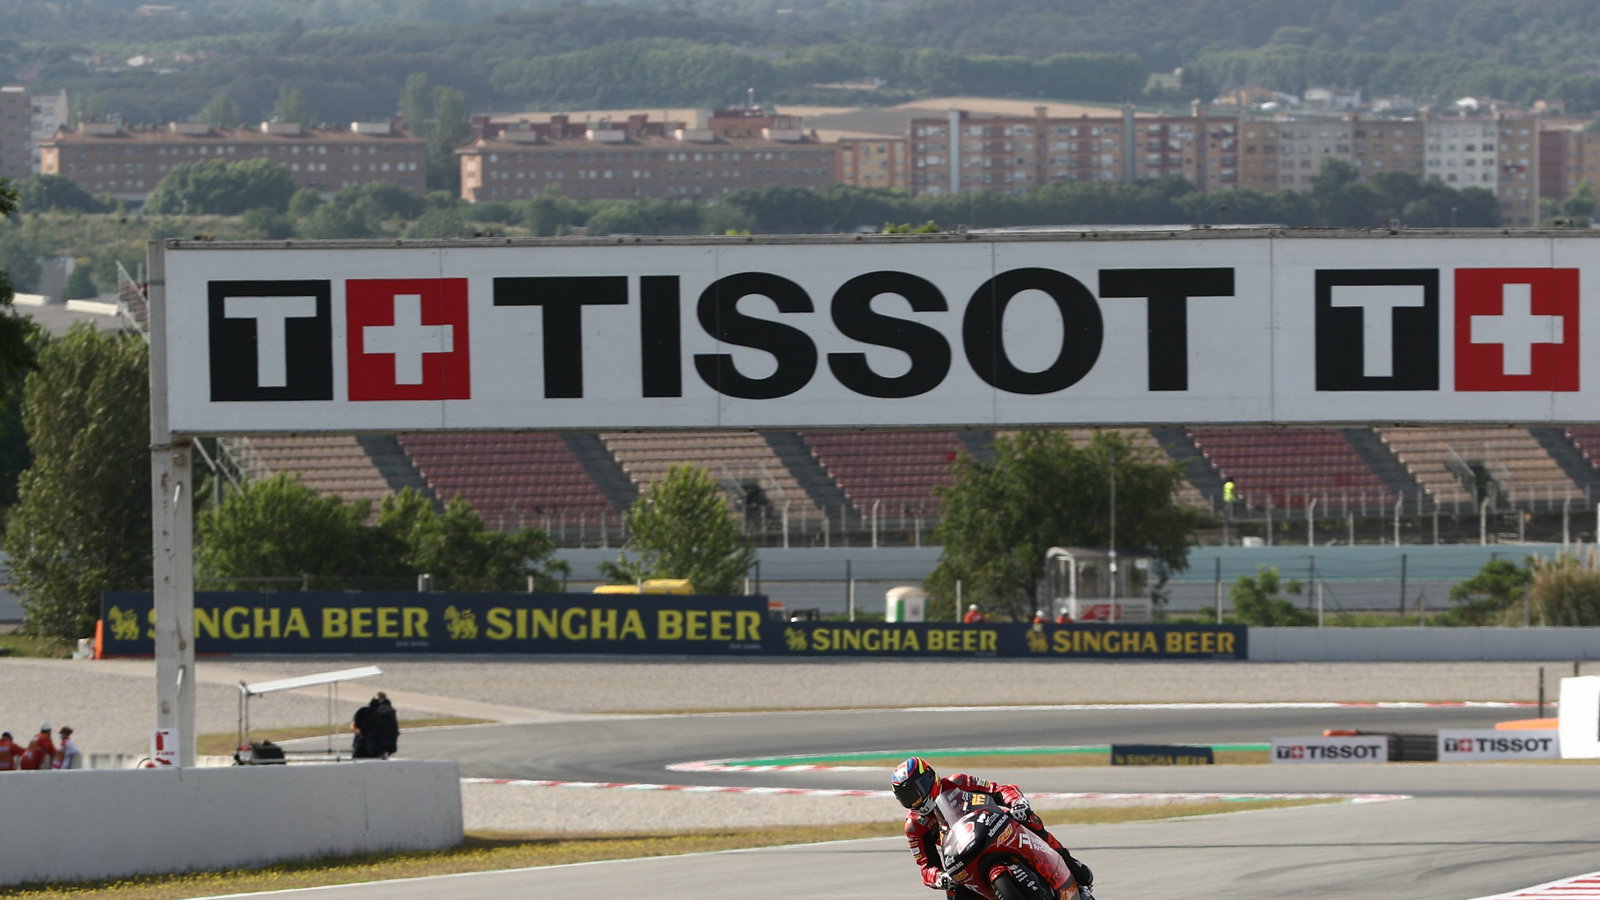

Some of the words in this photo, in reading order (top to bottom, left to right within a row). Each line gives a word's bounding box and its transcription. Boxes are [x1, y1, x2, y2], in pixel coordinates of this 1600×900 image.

[221, 293, 319, 390] T
[493, 269, 1235, 399] TISSOT
[1329, 283, 1427, 379] T
[147, 606, 309, 640] NGHA
[322, 607, 429, 639] BEER
[485, 607, 646, 641] SINGHA
[657, 609, 762, 641] BEER
[812, 628, 920, 651] SINGHA
[927, 629, 998, 651] BEER
[1053, 629, 1159, 653] SINGHA
[1165, 631, 1235, 653] BEER
[1306, 745, 1381, 759] TISSOT
[1476, 738, 1552, 752] TISSOT
